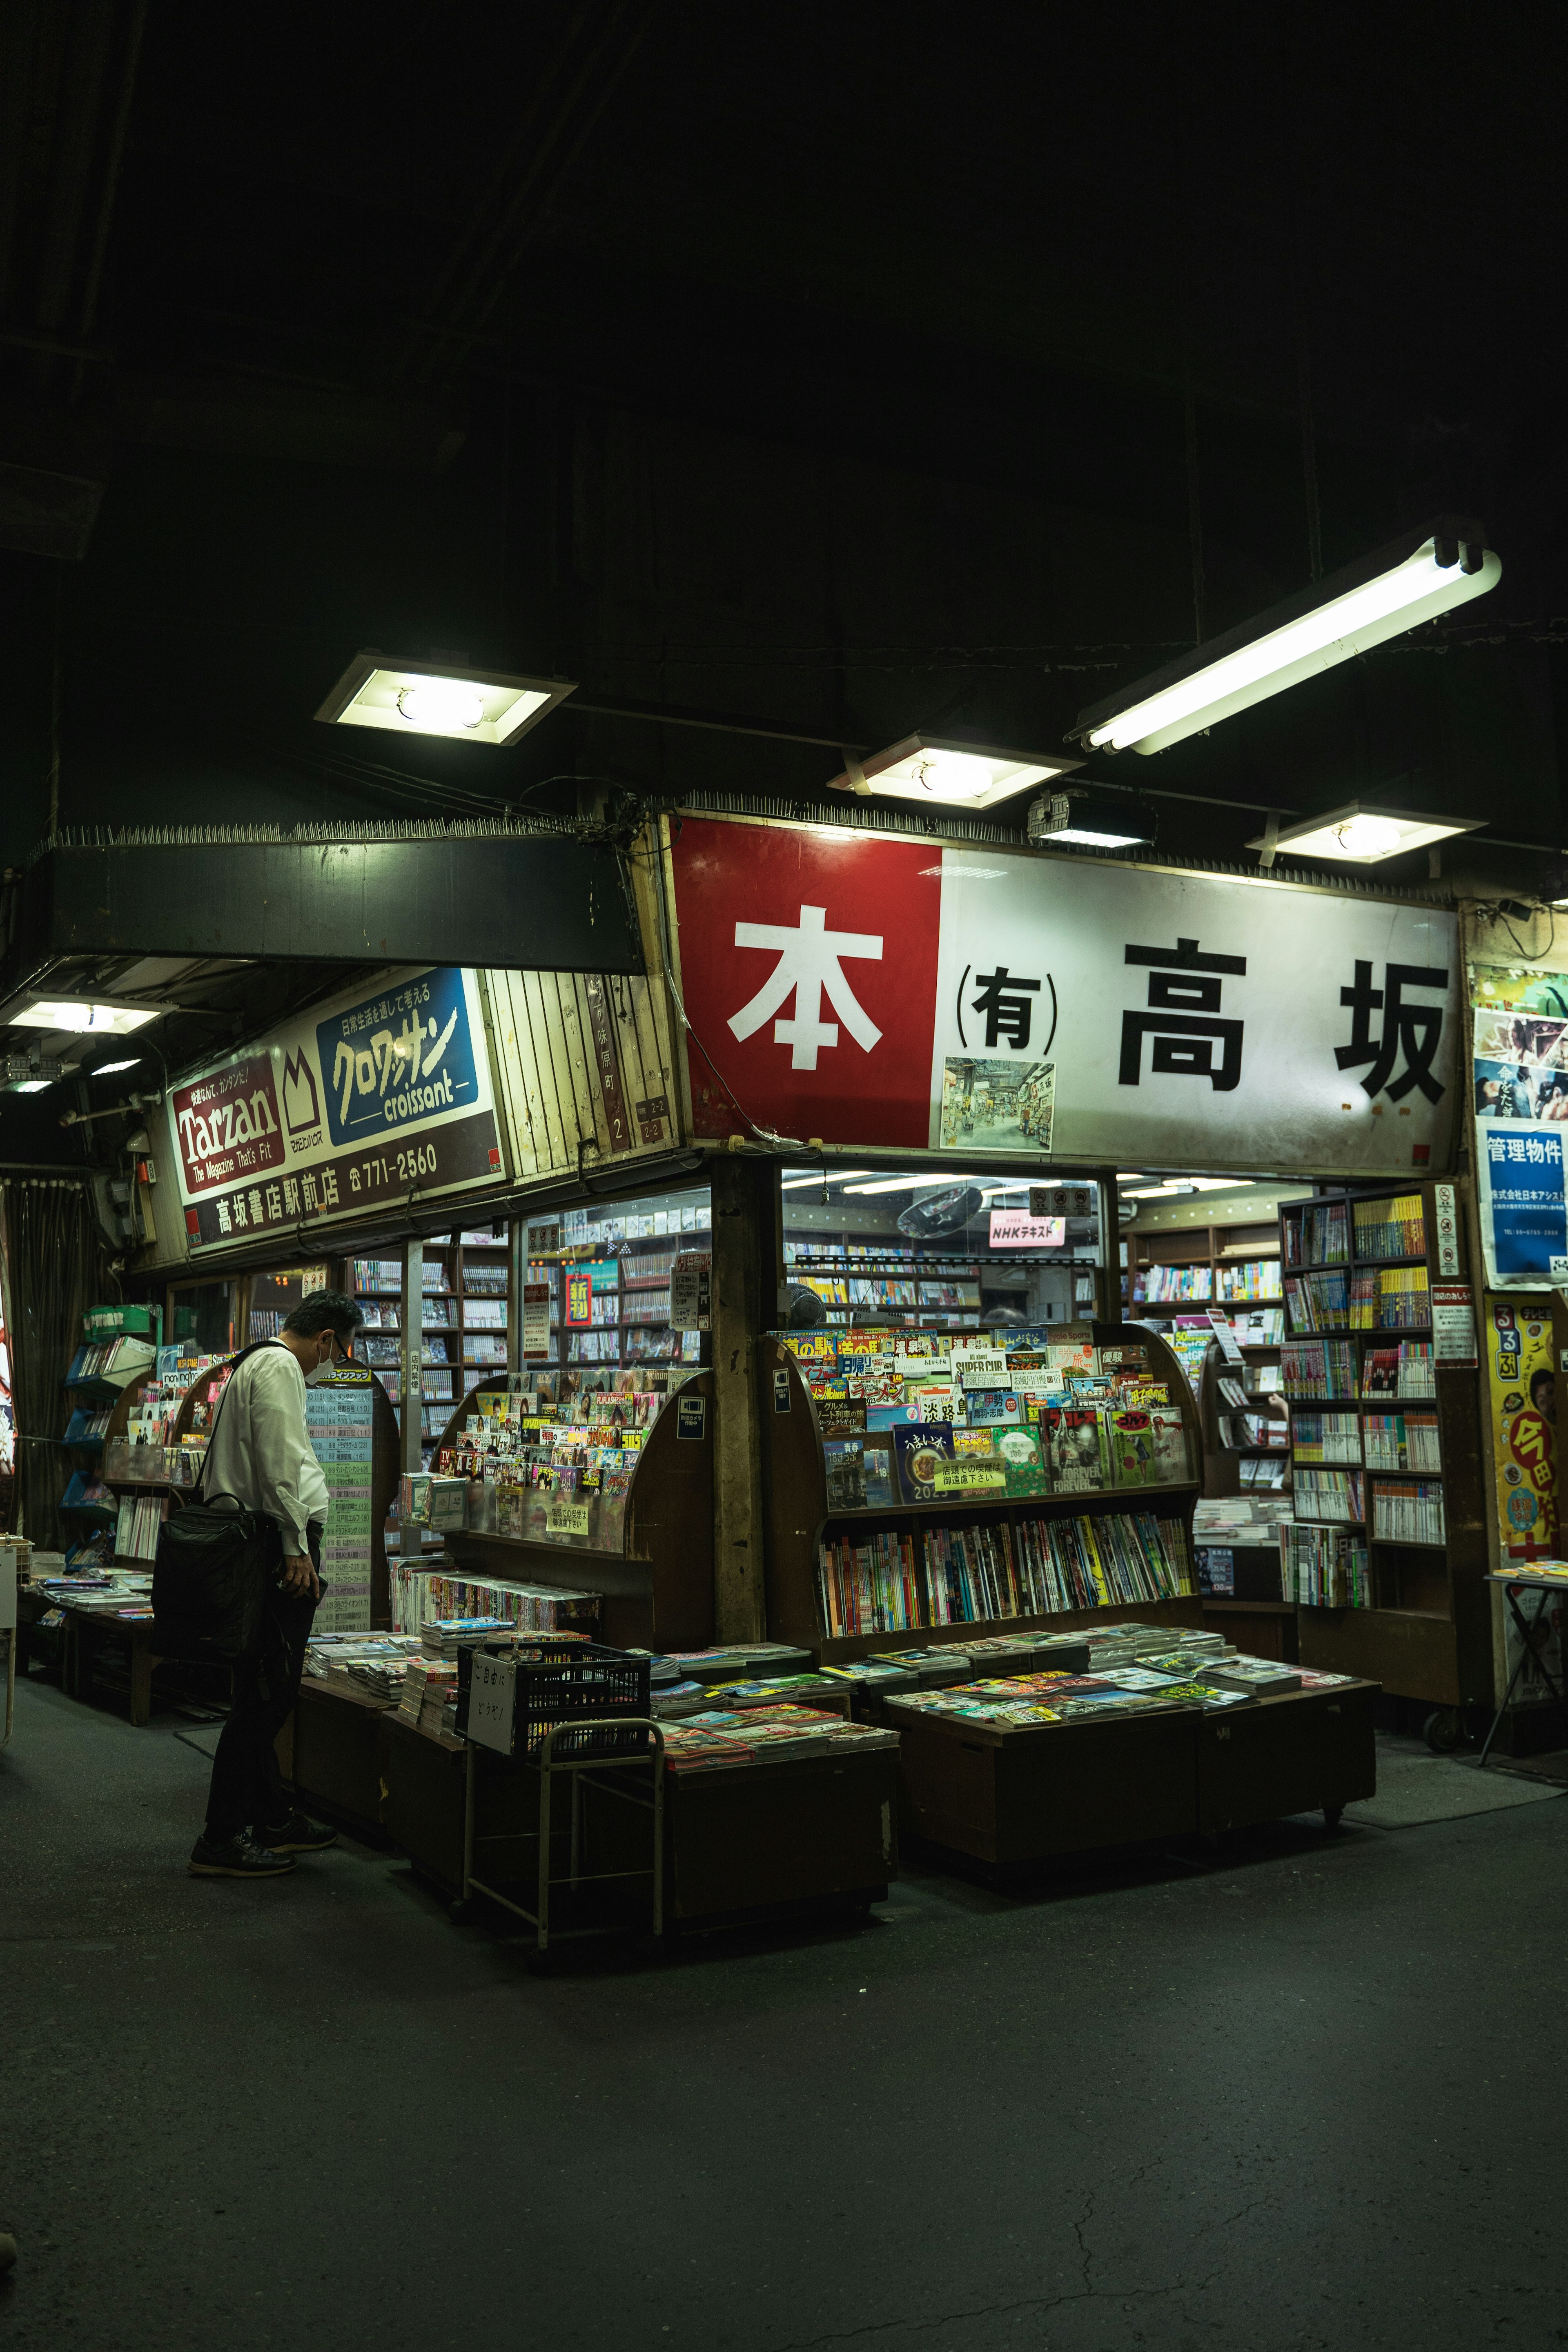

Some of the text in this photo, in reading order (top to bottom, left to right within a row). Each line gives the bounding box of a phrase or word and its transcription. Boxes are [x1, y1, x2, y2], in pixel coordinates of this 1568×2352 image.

[726, 904, 883, 1070] 本
[342, 983, 430, 1036] 日常生活を通して考える
[333, 1007, 457, 1126] クロワッサン
[593, 1004, 614, 1090] 下味原町
[614, 1119, 622, 1139] 2
[384, 1069, 454, 1122] croissant
[651, 1101, 664, 1113] 2-2
[179, 1090, 277, 1164] Tarzan
[645, 1125, 658, 1137] 2-2
[290, 1131, 323, 1153] マガジンハウス
[1487, 1137, 1561, 1164] 管理物件
[193, 1142, 272, 1183] The Magazine That's Fit
[216, 1144, 437, 1234] 高坂書店駅前店 771-2560
[1492, 1189, 1564, 1200] 株式会社日本アシスト
[993, 1226, 1052, 1239] NHKテキスト
[570, 1281, 587, 1320] 新刊
[1069, 1332, 1090, 1340] Sports
[1176, 1332, 1187, 1341] 50
[896, 1341, 918, 1353] 温泉
[187, 1358, 198, 1368] STAGE
[1102, 1352, 1123, 1363] 優駿
[842, 1357, 871, 1374] 日帰り
[956, 1361, 984, 1373] SUPER
[965, 1376, 1009, 1387] お風呂自慢の宿
[1013, 1373, 1061, 1385] お風呂自慢の宿
[851, 1381, 903, 1402] ラーメン
[985, 1394, 1003, 1407] 伊勢
[974, 1409, 1004, 1419] 鳥羽・志摩
[1120, 1416, 1147, 1425] ゴルフ
[542, 1432, 557, 1440] 残酷の
[844, 1443, 859, 1453] 青春
[441, 1451, 450, 1460] TV
[828, 1452, 856, 1463] 18きっぷ
[879, 1468, 886, 1477] 18
[943, 1463, 1001, 1475] 店頭での喫煙は
[943, 1473, 993, 1486] 御遠慮下さい
[552, 1508, 586, 1519] 店頭での喫煙は
[553, 1519, 581, 1528] 御遠慮下さい
[476, 1666, 504, 1685] ご自由に
[479, 1703, 503, 1720] どうぞ!
